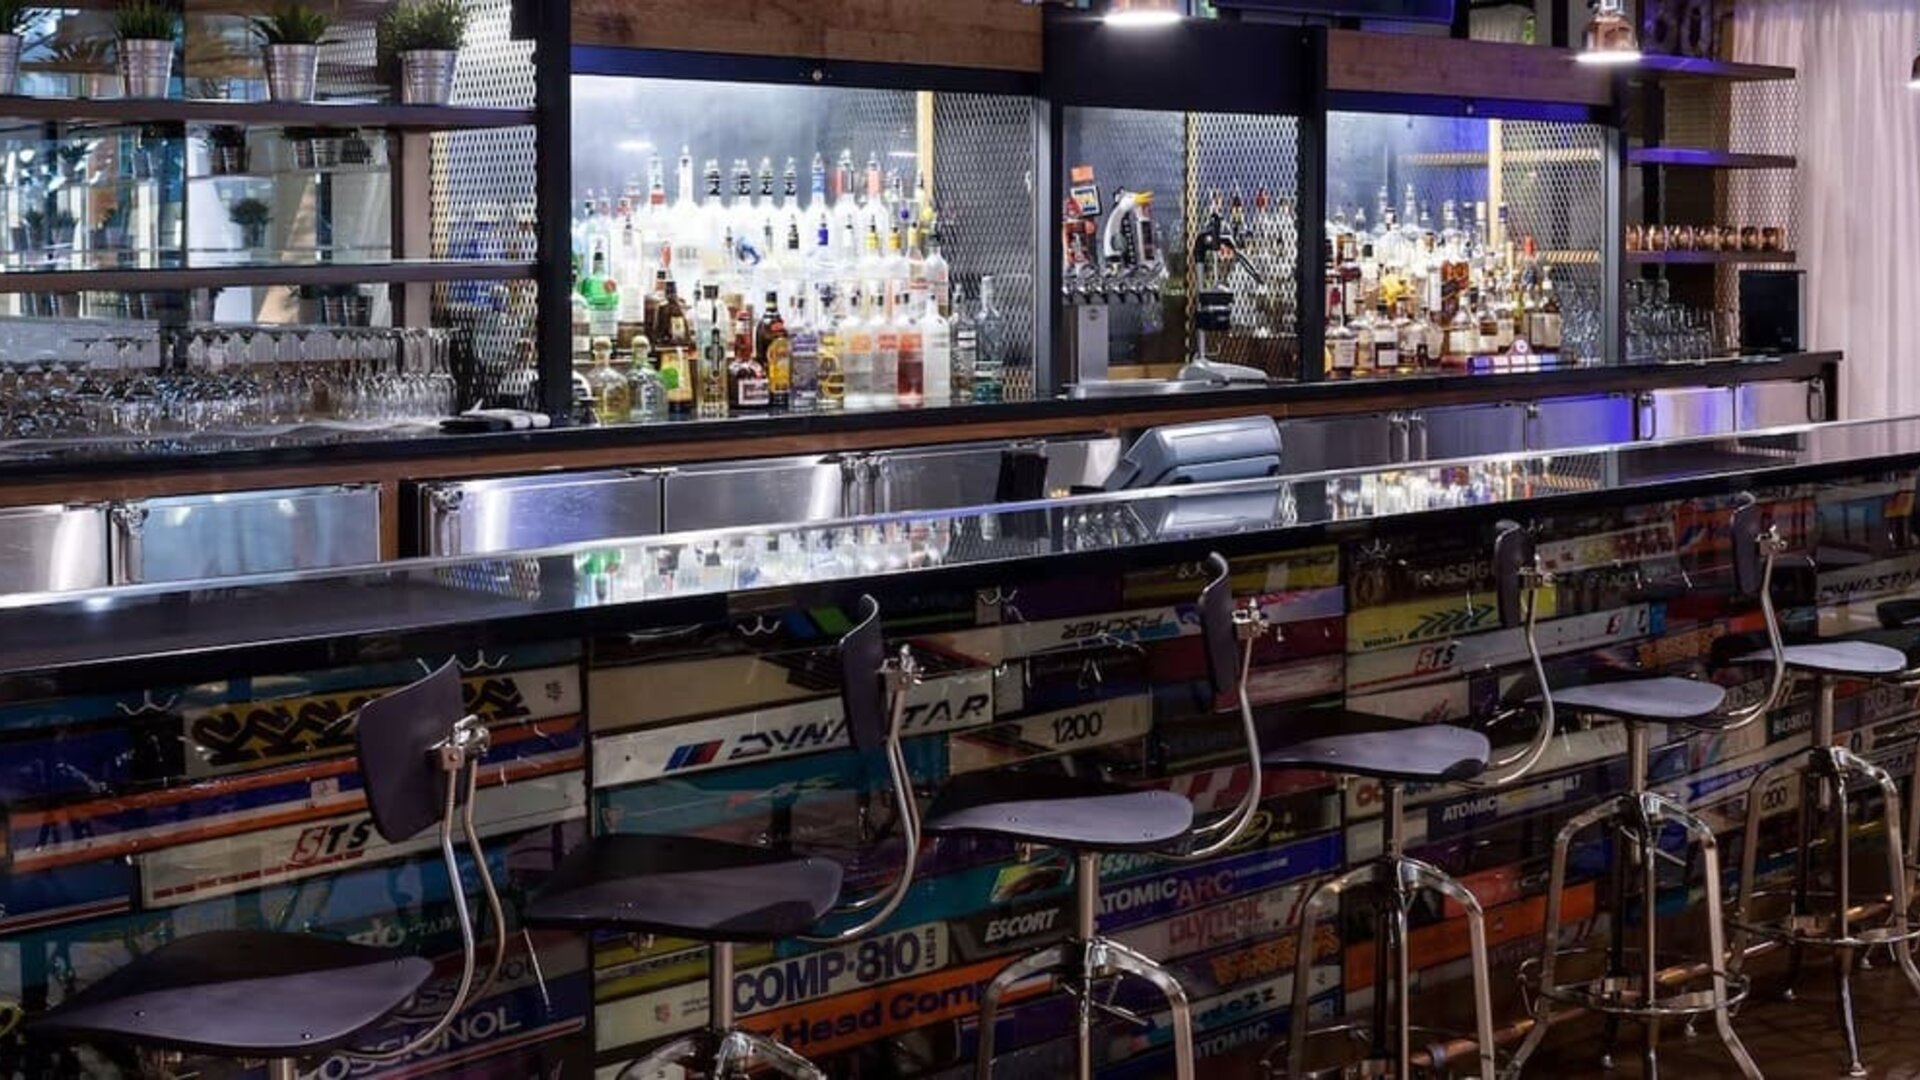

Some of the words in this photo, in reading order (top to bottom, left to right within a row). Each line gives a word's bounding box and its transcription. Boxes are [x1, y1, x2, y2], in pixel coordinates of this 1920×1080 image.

[1052, 711, 1103, 744] 1200
[1172, 868, 1235, 907] ARC
[984, 907, 1060, 943] ESCORT
[783, 1000, 883, 1046] Head
